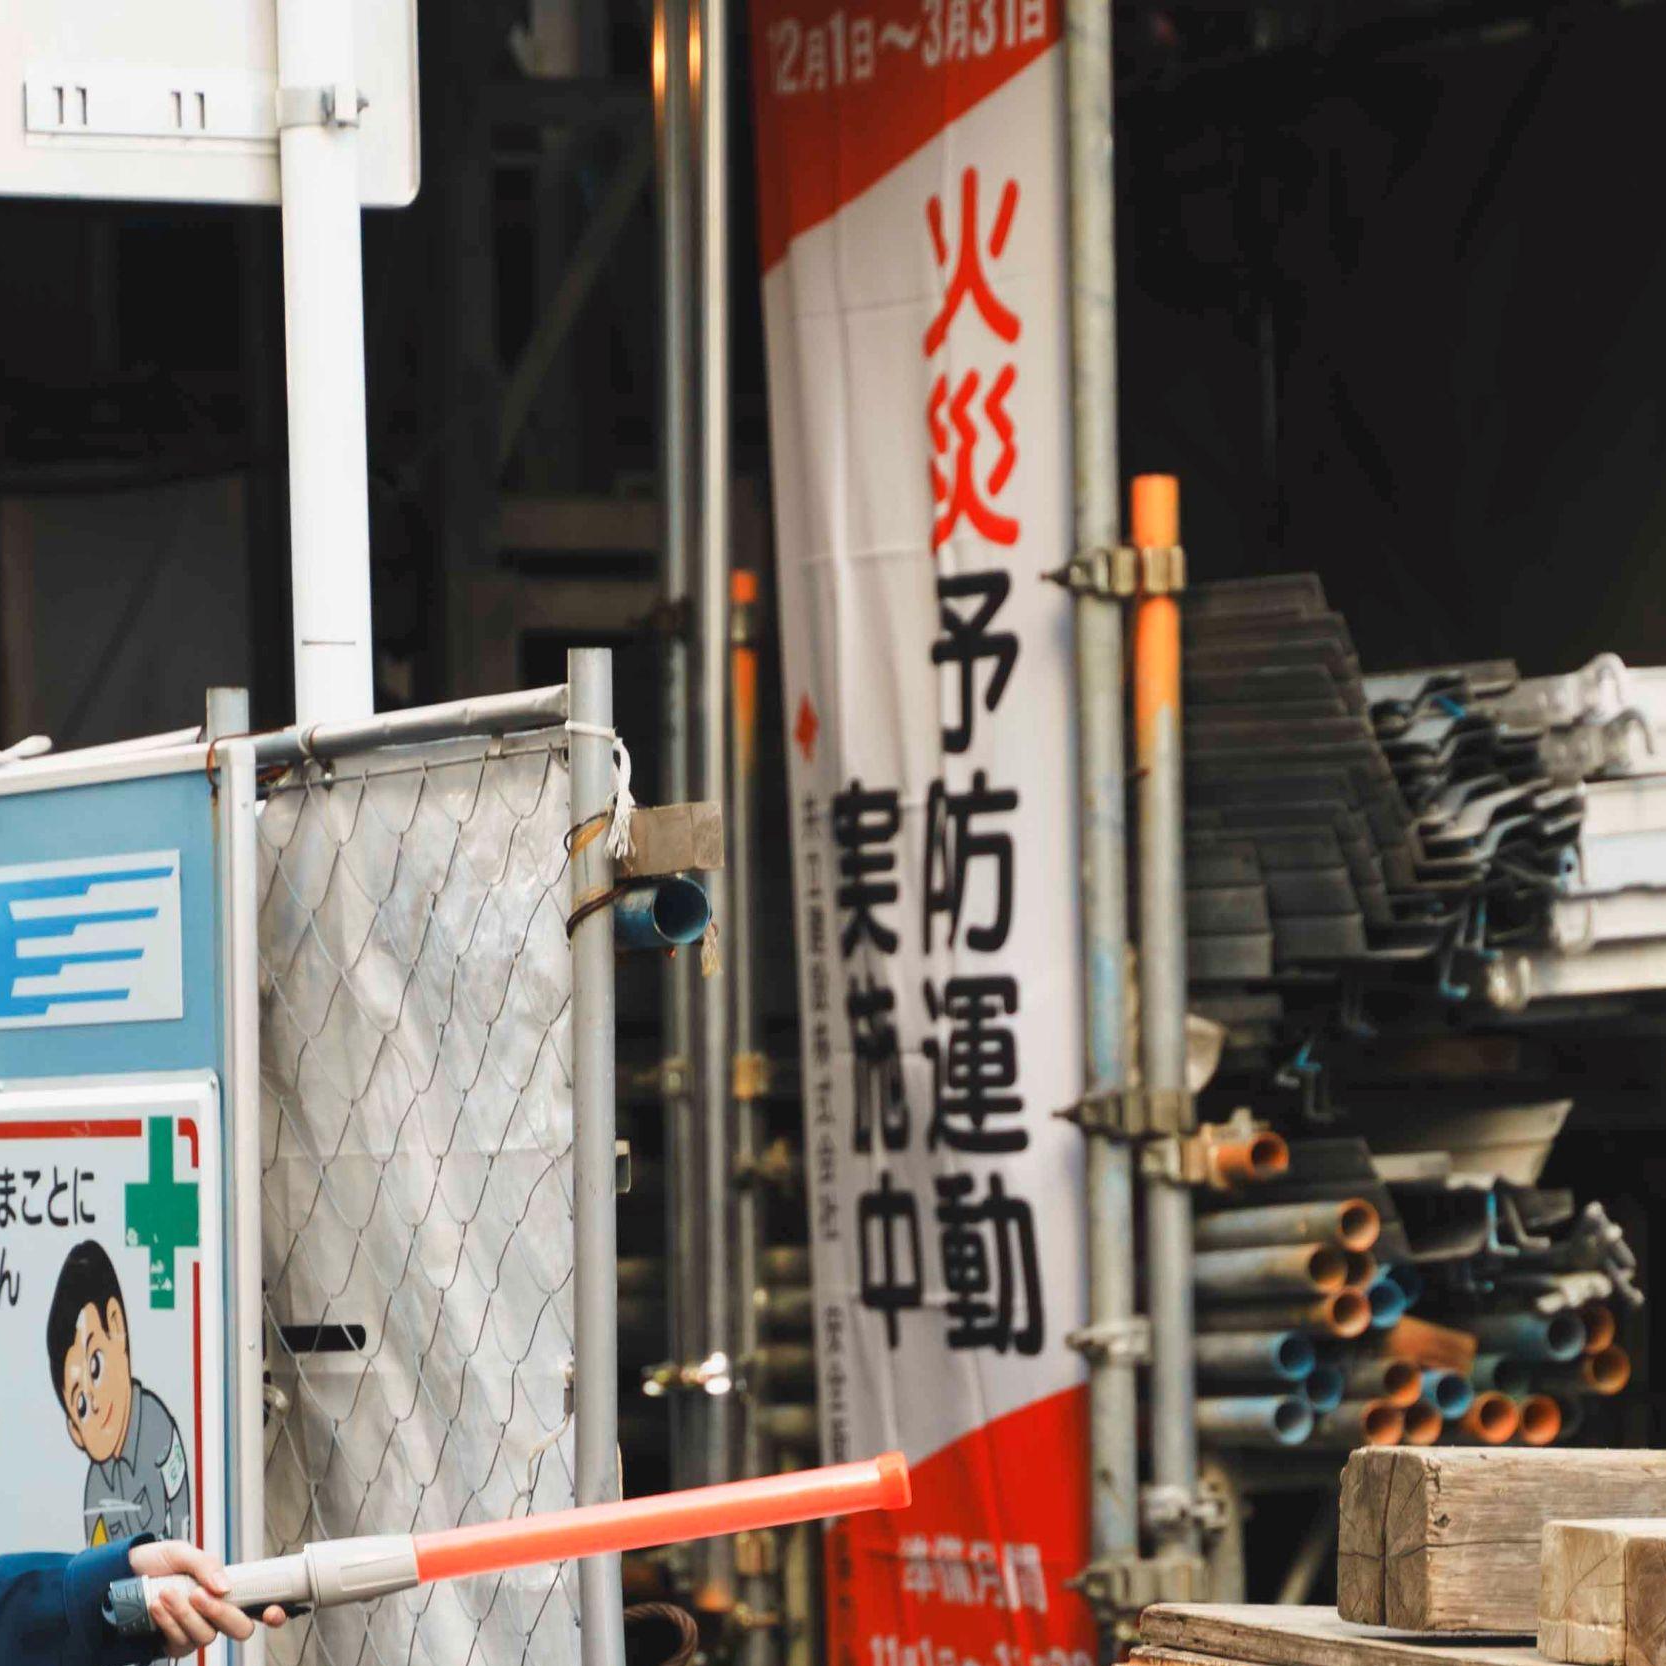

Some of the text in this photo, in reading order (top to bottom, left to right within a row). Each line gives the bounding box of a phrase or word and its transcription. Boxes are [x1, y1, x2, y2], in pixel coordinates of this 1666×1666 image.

[923, 165, 1044, 1356] 火災予防運動
